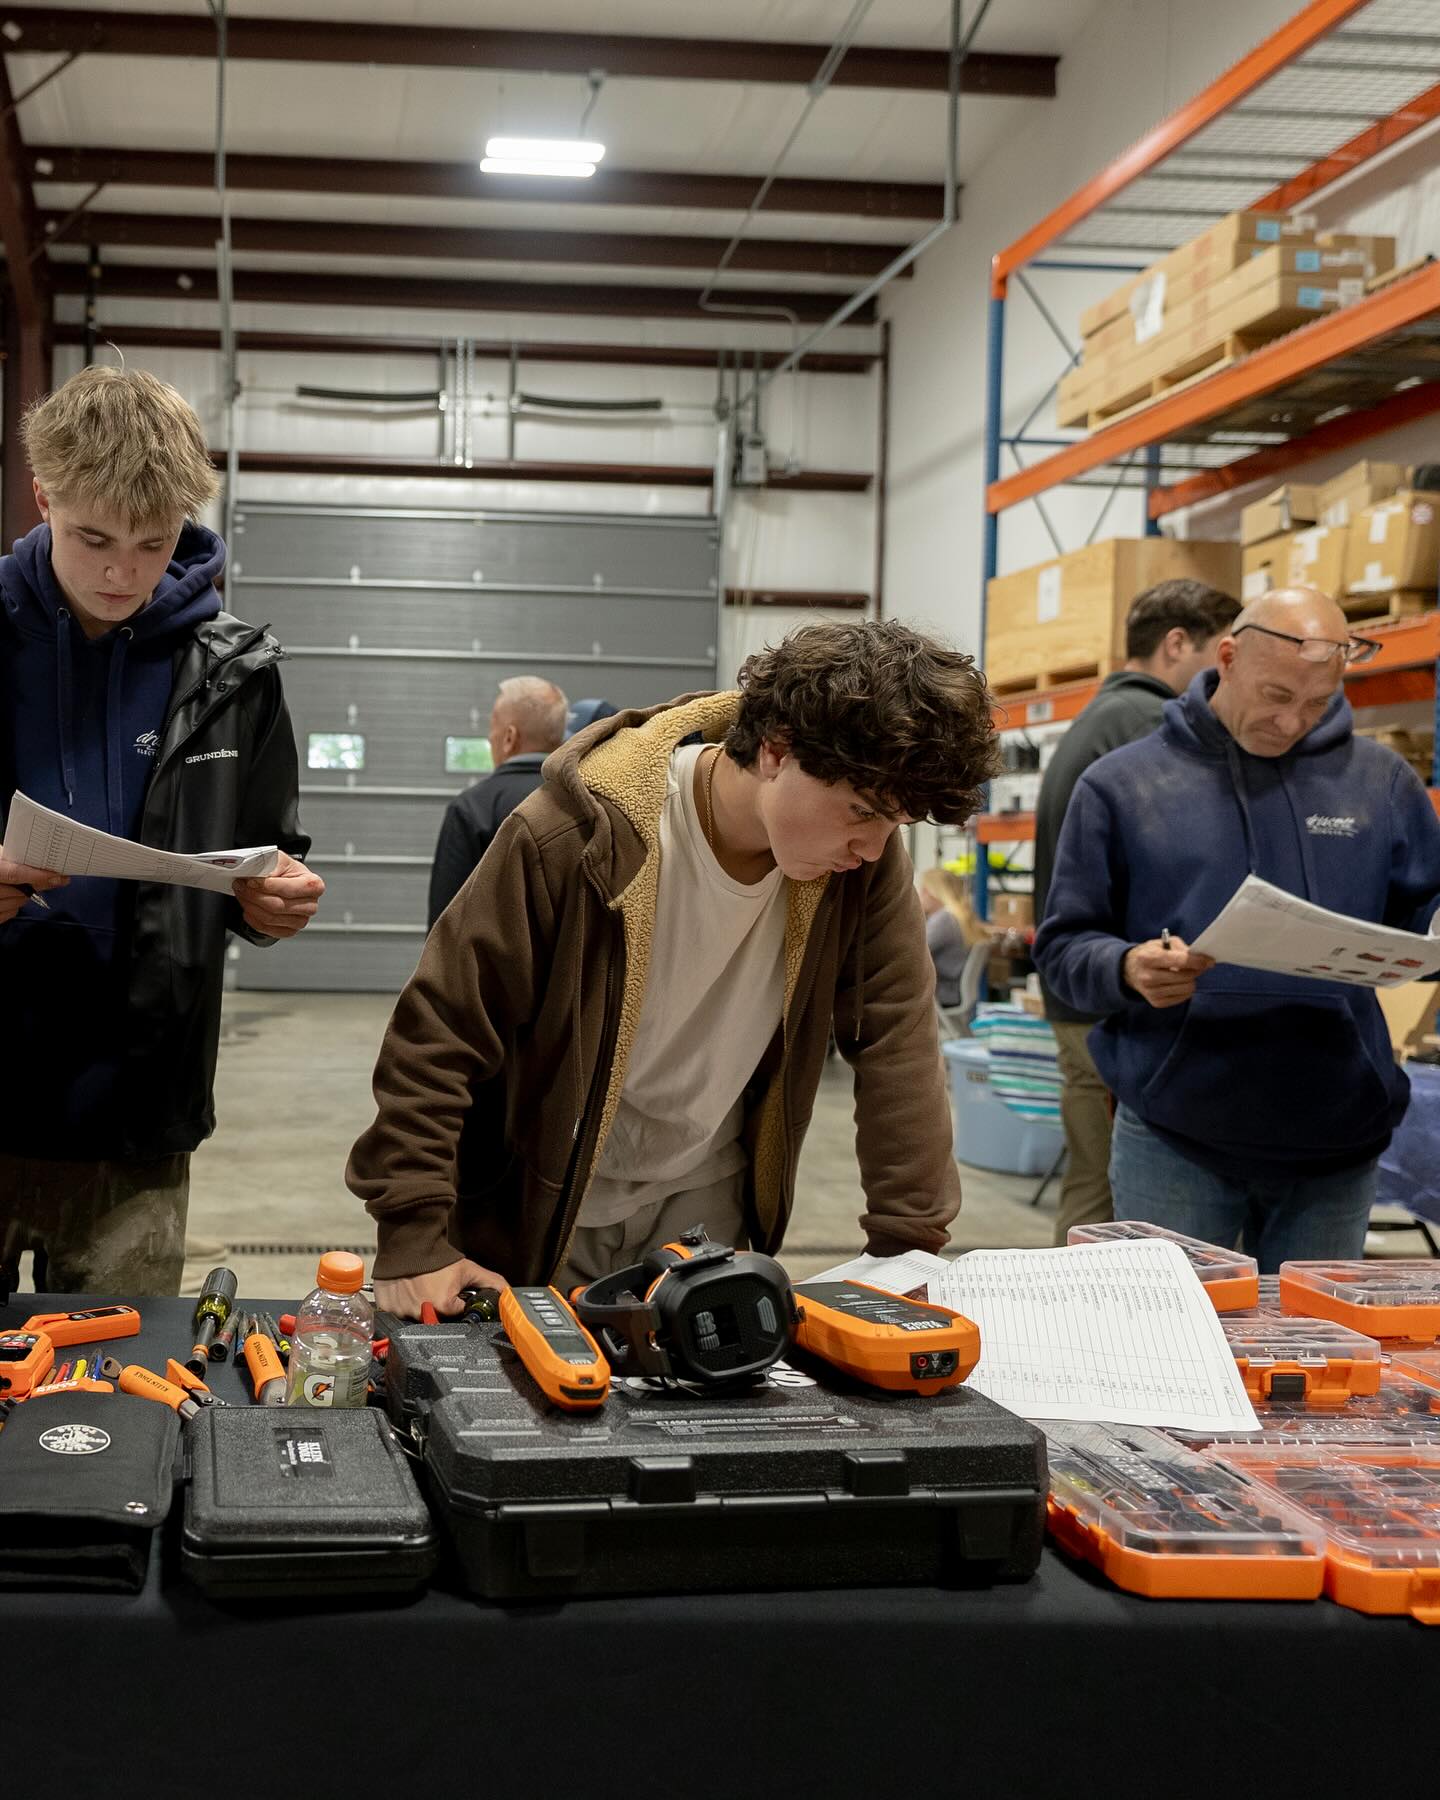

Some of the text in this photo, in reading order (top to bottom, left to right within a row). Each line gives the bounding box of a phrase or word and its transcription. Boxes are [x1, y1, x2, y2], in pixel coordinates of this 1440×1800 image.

[303, 1374, 335, 1407] G
[297, 1441, 312, 1463] TOOLS
[309, 1442, 324, 1463] KLEIN
